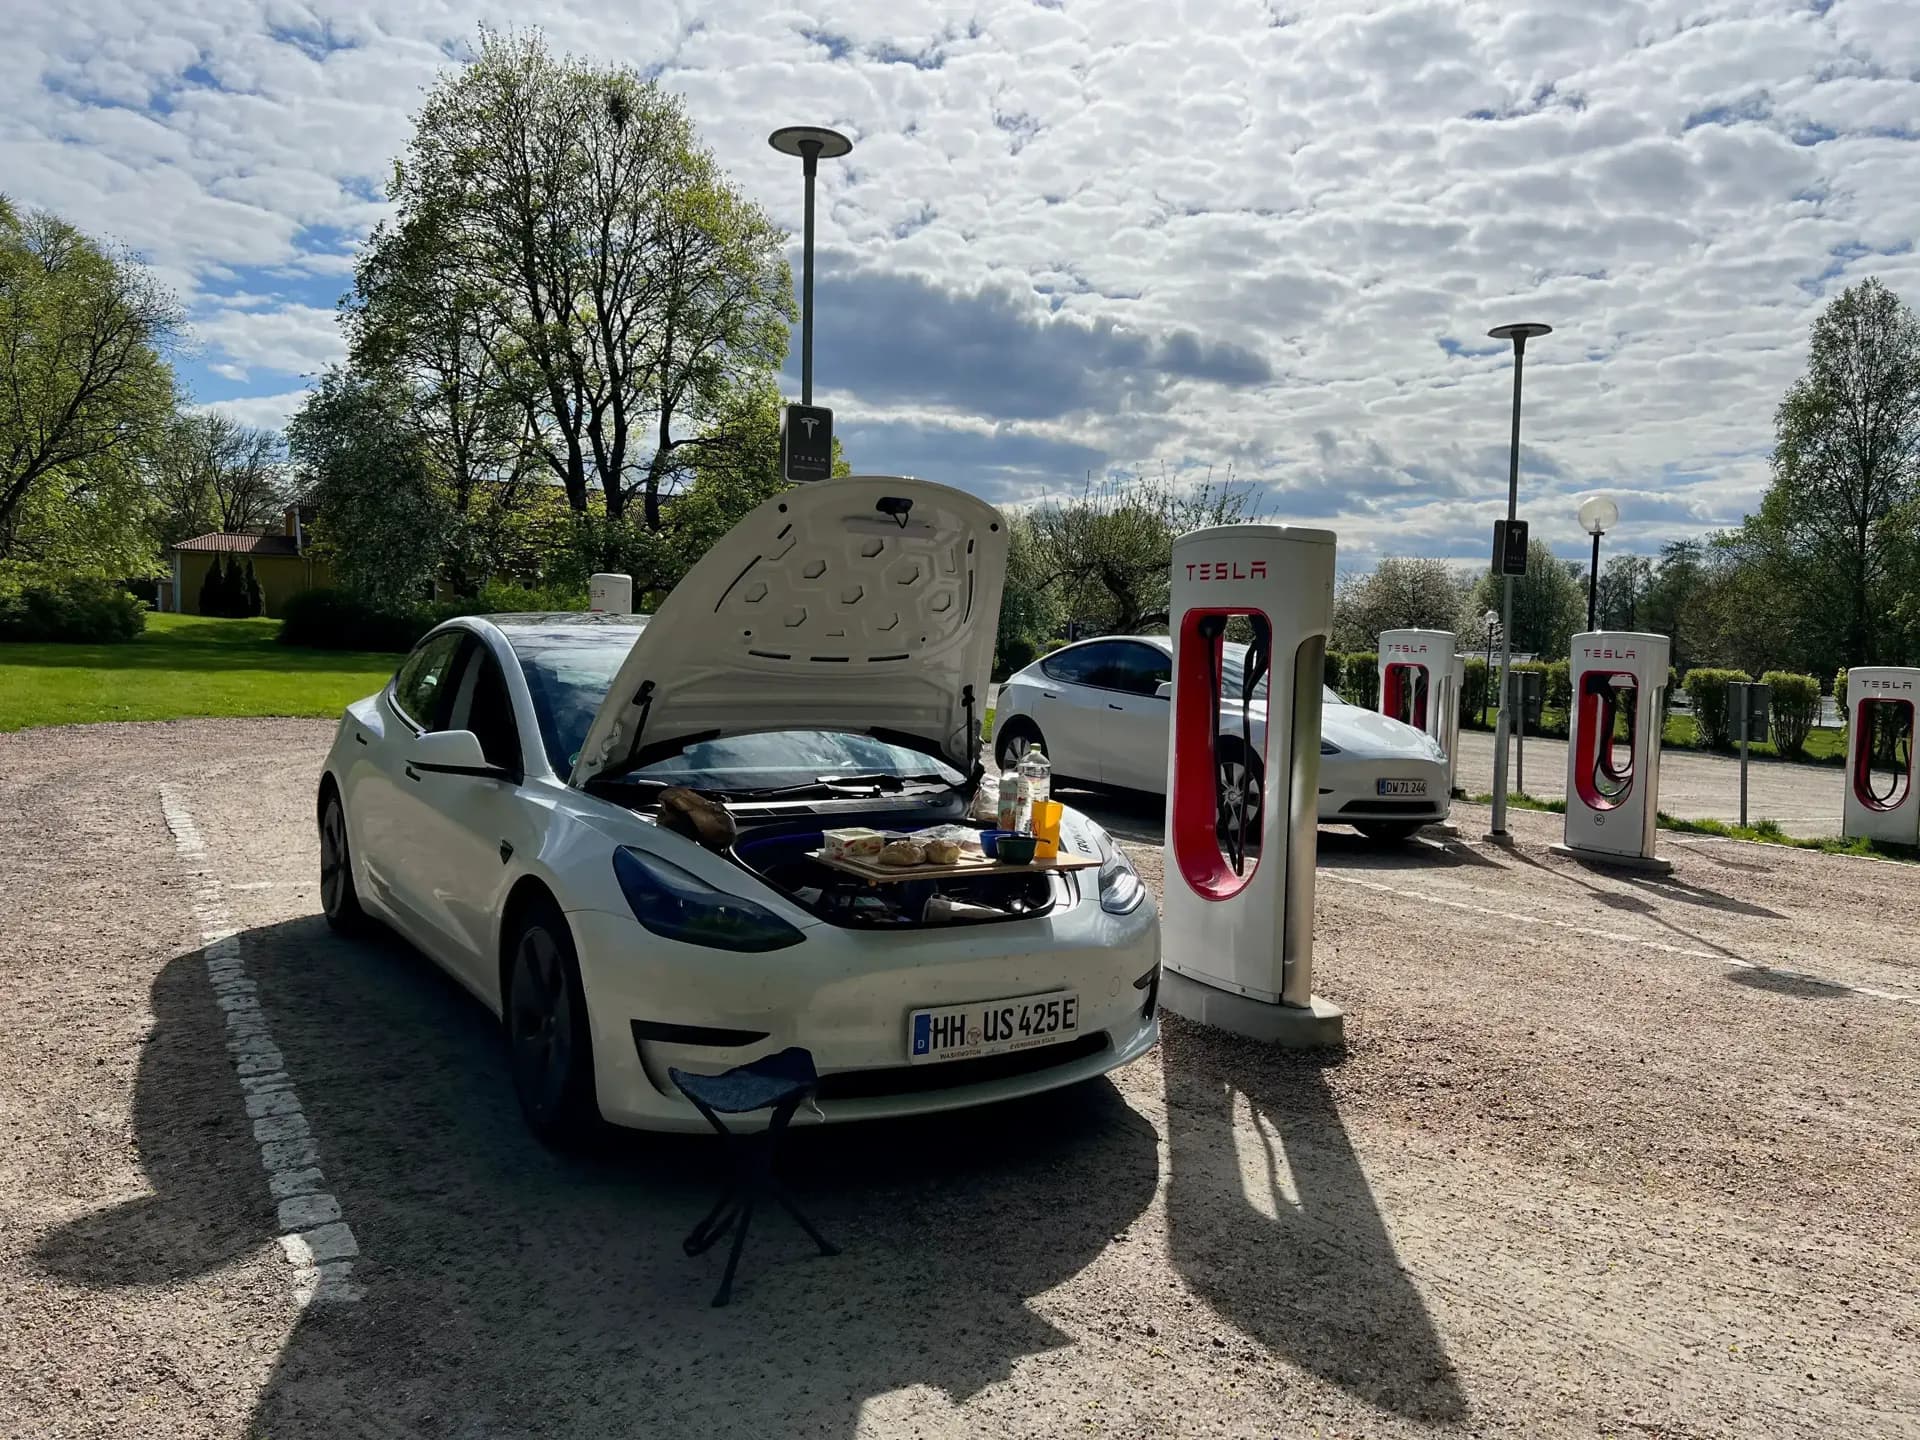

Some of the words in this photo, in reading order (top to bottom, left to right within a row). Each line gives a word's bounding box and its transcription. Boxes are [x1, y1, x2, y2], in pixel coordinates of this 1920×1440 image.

[1186, 561, 1267, 581] TESLA
[1387, 644, 1428, 653] TESLA
[1583, 648, 1636, 659] TESLA
[1861, 680, 1912, 690] TESLA
[1400, 782, 1409, 793] 71
[932, 1014, 966, 1050] HH
[983, 1008, 1014, 1043] US
[1019, 998, 1076, 1037] 425E
[917, 1039, 925, 1049] D
